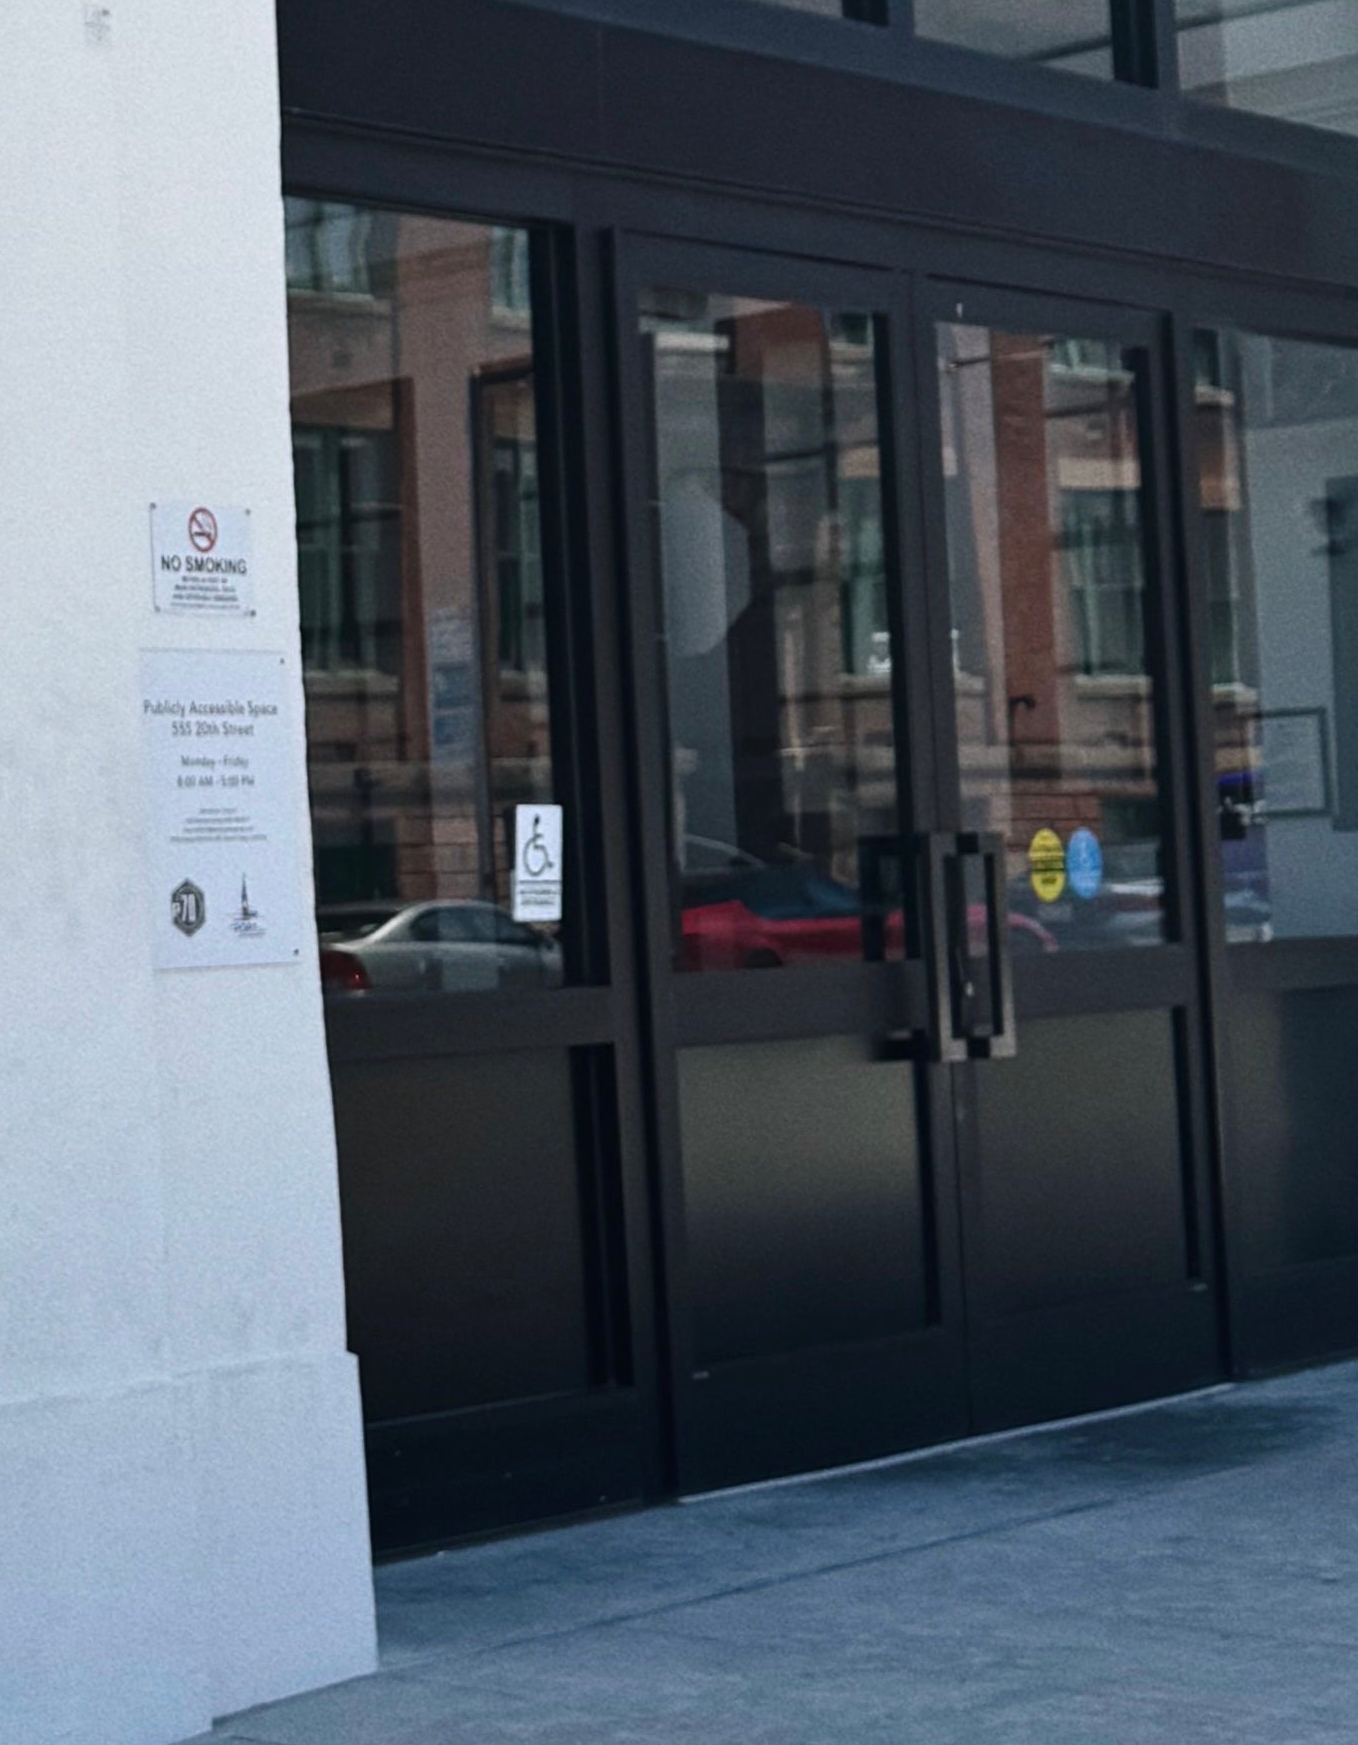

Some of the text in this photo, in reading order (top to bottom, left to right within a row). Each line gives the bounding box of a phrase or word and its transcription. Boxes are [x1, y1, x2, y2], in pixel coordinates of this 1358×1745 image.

[161, 554, 247, 576] NO SMOKING
[143, 699, 278, 718] Publicly Accessible Space
[172, 721, 254, 736] 555 20th Street
